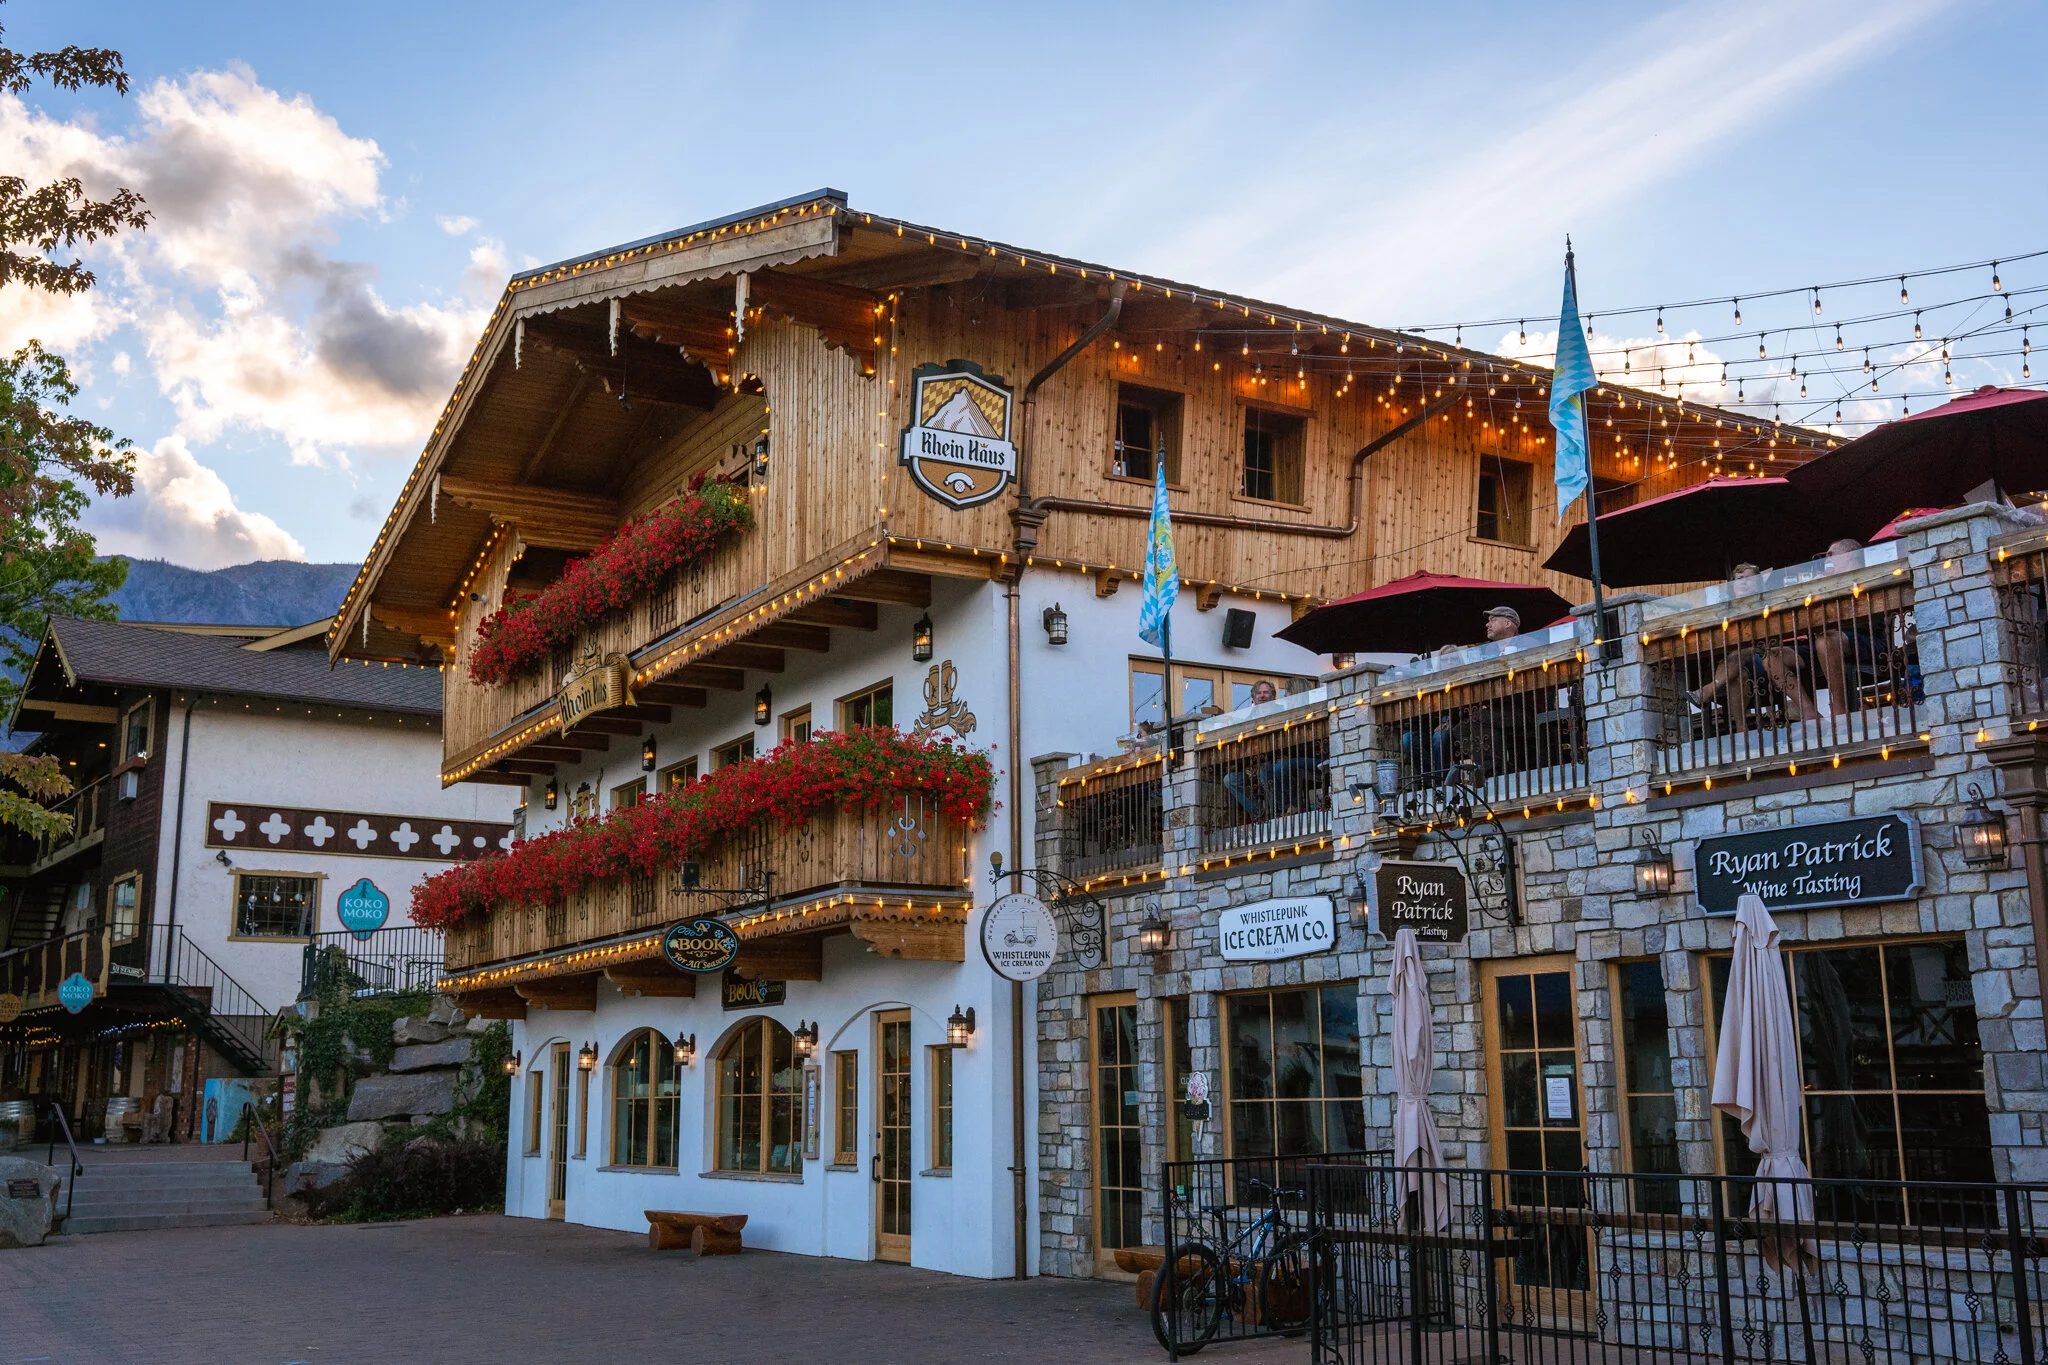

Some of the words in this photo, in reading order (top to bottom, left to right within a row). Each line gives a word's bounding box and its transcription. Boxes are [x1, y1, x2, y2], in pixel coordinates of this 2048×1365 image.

[921, 432, 964, 460] Rhein
[968, 439, 1005, 465] Haus
[560, 686, 592, 725] Rhein
[1709, 850, 1780, 884] Ryan
[1784, 823, 1893, 868] Patrick
[1397, 875, 1446, 903] Ryan
[1743, 880, 1788, 899] Wine
[1792, 869, 1861, 899] Tasting
[345, 898, 383, 909] KOKO
[1391, 898, 1454, 920] Patrick
[343, 908, 383, 919] MOKO
[1240, 904, 1308, 925] WHISTLEPUNK
[696, 923, 709, 933] A
[1224, 931, 1245, 950] ICE
[1247, 923, 1299, 948] CREAM
[1302, 920, 1329, 941] CO.
[1421, 924, 1448, 940] Tasting
[678, 938, 732, 954] BOOK
[992, 950, 1051, 960] WHISTLEPUNK
[672, 952, 689, 964] For
[685, 960, 701, 969] All
[702, 952, 731, 969] Seasons
[1000, 960, 1010, 968] ICE
[62, 985, 90, 993] KOKO
[728, 981, 765, 1003] BOOK
